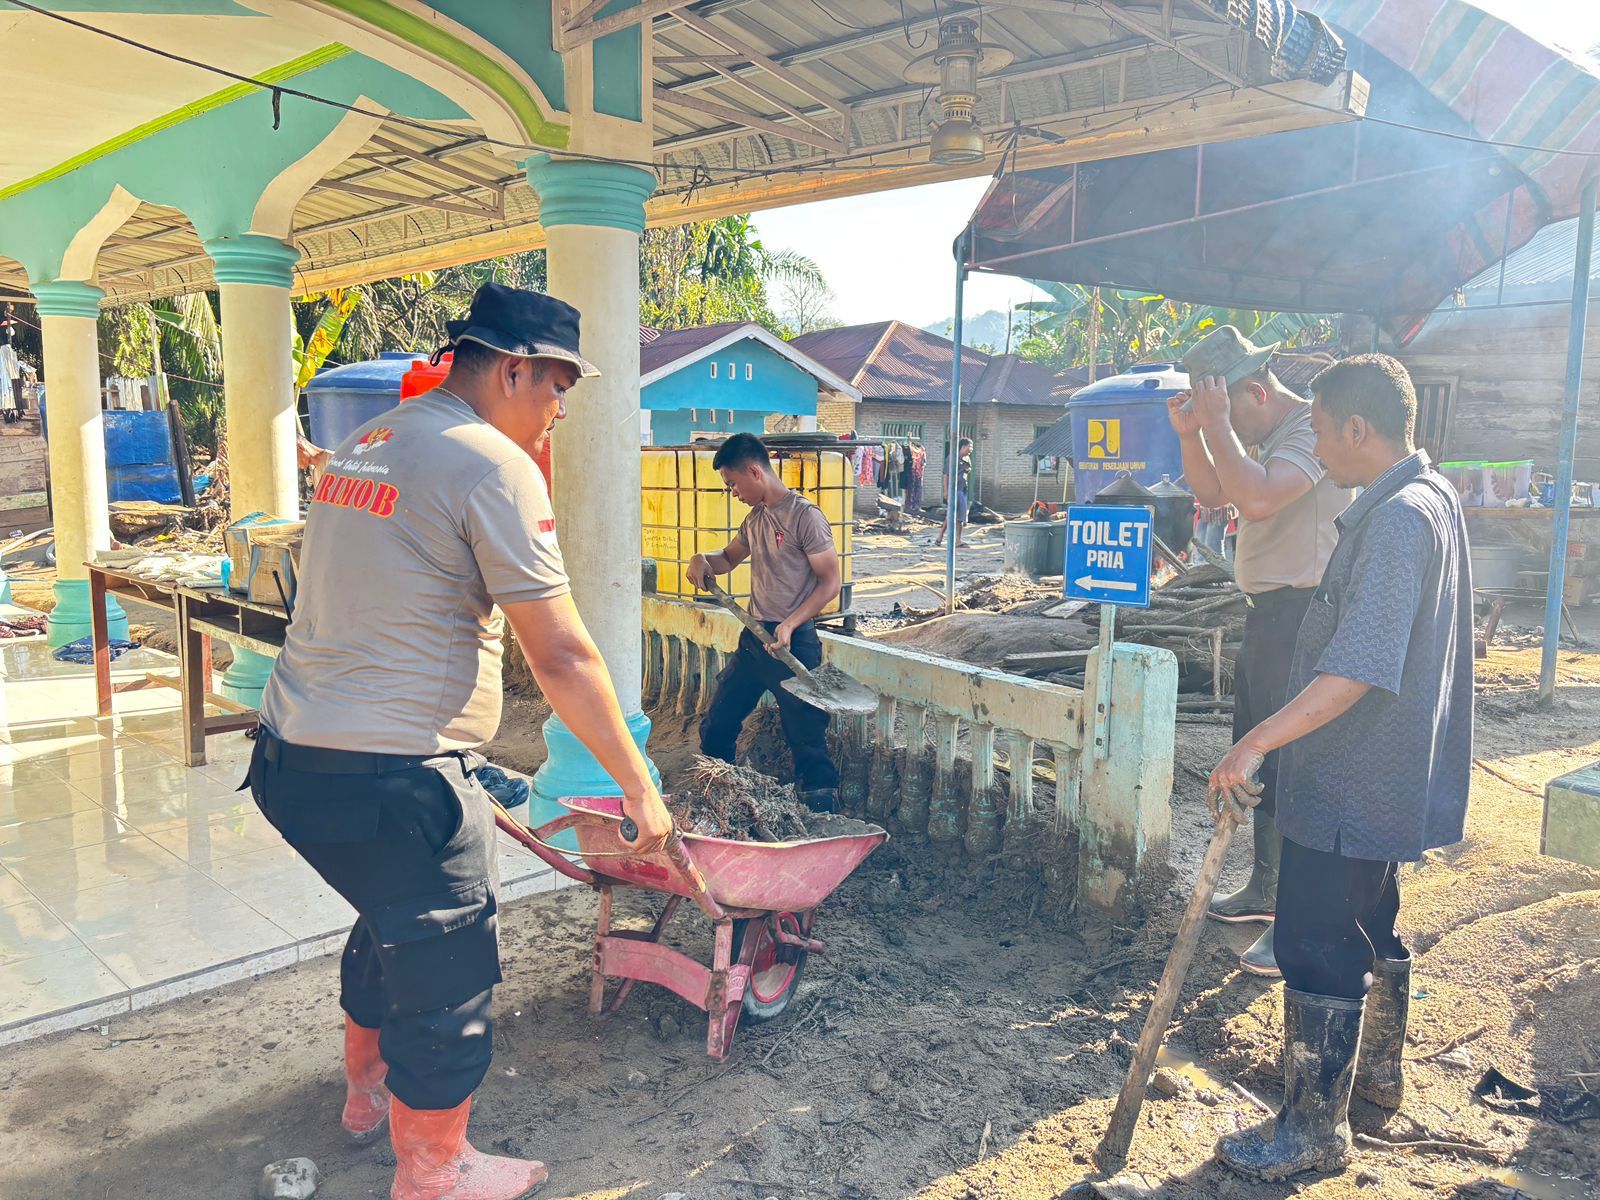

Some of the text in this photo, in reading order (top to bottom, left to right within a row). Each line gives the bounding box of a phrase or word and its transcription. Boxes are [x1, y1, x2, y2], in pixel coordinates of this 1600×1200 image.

[313, 473, 400, 518] RIMOB
[1069, 520, 1148, 547] TOILET
[1086, 550, 1124, 569] PRIA
